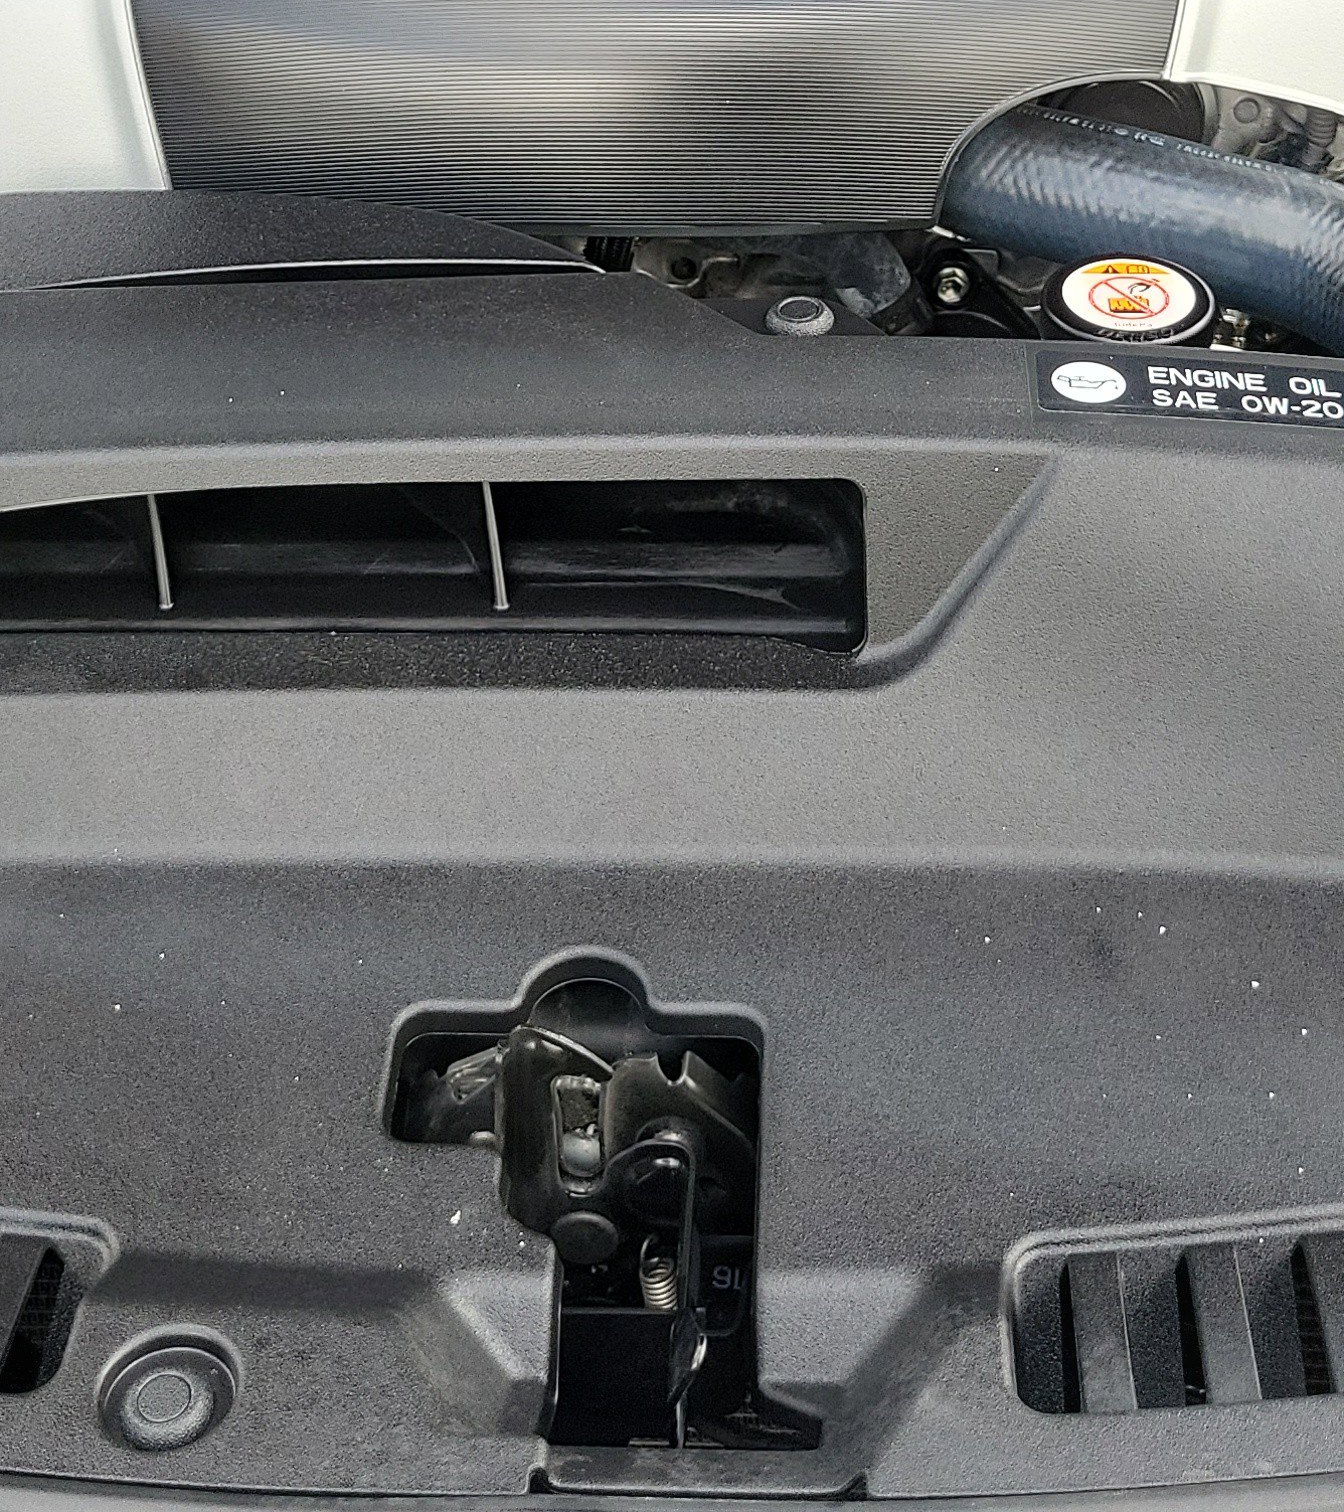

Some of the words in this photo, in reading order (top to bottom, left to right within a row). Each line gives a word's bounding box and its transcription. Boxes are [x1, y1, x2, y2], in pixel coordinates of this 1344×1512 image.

[1146, 365, 1268, 393] ENGINE
[1287, 374, 1343, 399] OIL
[1151, 387, 1219, 411] SAE
